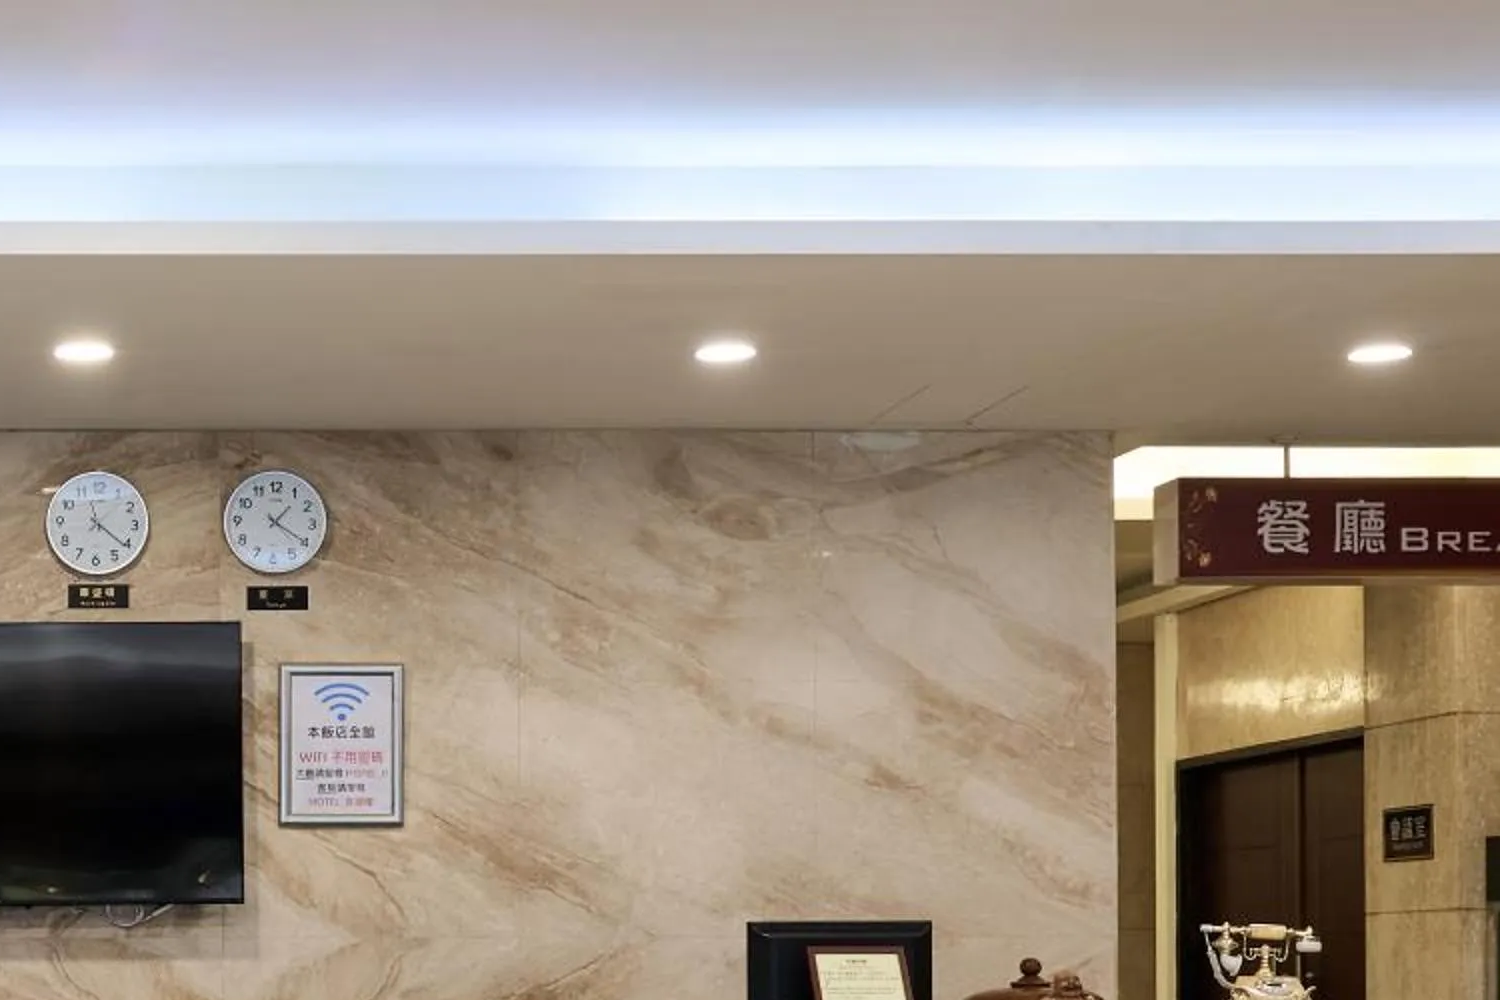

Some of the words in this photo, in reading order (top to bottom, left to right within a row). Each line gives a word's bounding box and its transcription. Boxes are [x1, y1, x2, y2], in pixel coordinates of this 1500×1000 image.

[76, 485, 87, 498] 11
[93, 481, 107, 494] 12
[253, 485, 264, 497] 11
[270, 481, 283, 493] 12
[63, 499, 74, 510] 10
[126, 501, 135, 513] 2
[239, 498, 253, 509] 10
[303, 500, 312, 513] 2
[55, 516, 65, 527] 9
[131, 520, 139, 531] 3
[233, 515, 243, 527] 9
[308, 518, 317, 531] 3
[1257, 500, 1386, 554] 餐廳
[1401, 527, 1500, 552] BRE
[61, 534, 69, 547] 8
[123, 538, 131, 548] 4
[238, 533, 246, 546] 8
[300, 537, 309, 547] 4
[75, 548, 83, 560] 7
[110, 549, 119, 561] 5
[253, 546, 261, 558] 7
[269, 552, 277, 564] 6
[288, 547, 296, 560] 5
[92, 555, 100, 566] 6
